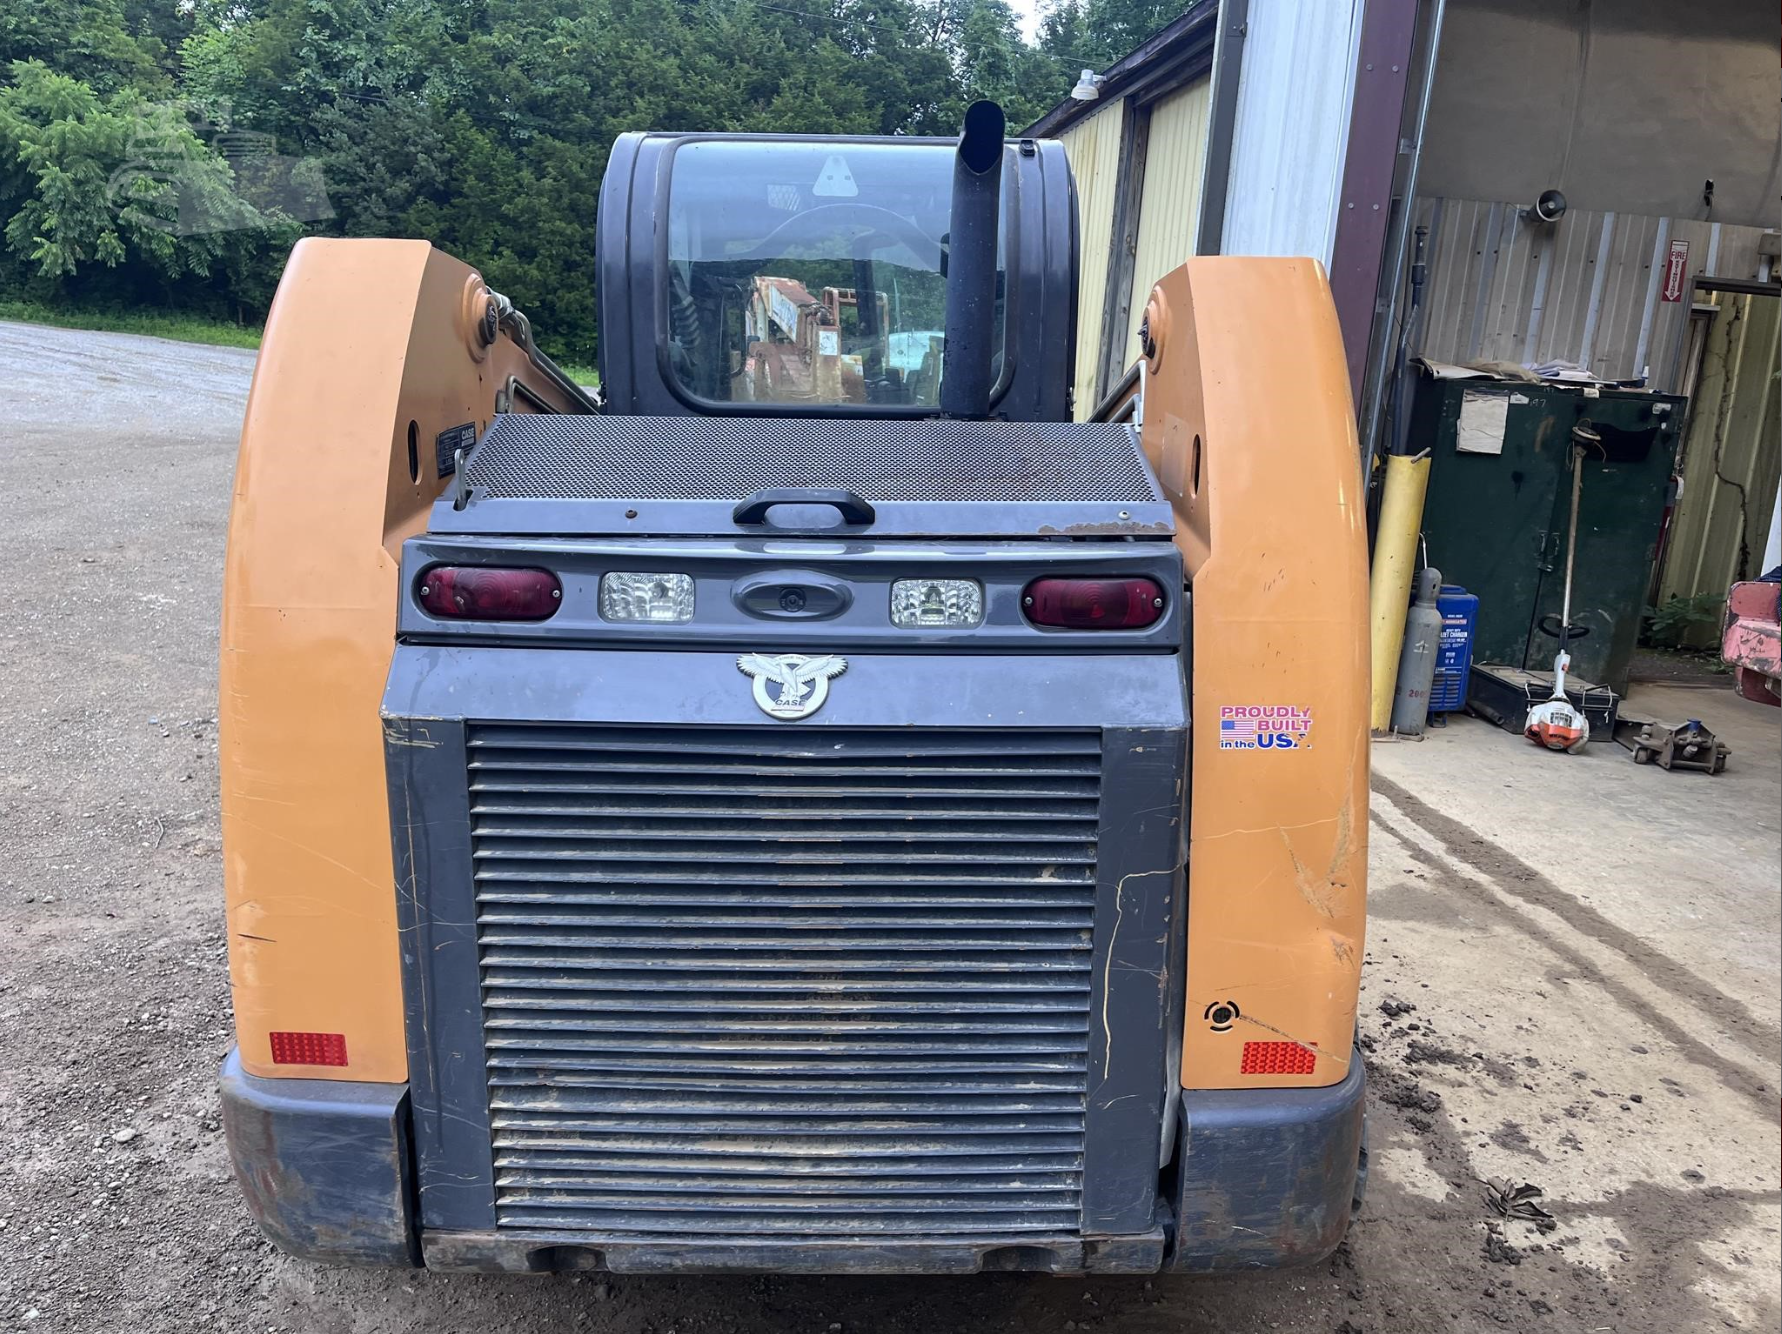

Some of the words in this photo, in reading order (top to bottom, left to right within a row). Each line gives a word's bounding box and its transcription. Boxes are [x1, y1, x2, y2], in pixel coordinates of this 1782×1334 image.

[1671, 250, 1687, 260] FIRE
[461, 427, 475, 440] CASE
[1220, 706, 1311, 718] PROUDLY
[1257, 720, 1312, 731] BUILT
[1220, 740, 1232, 749] in
[1234, 740, 1255, 749] the
